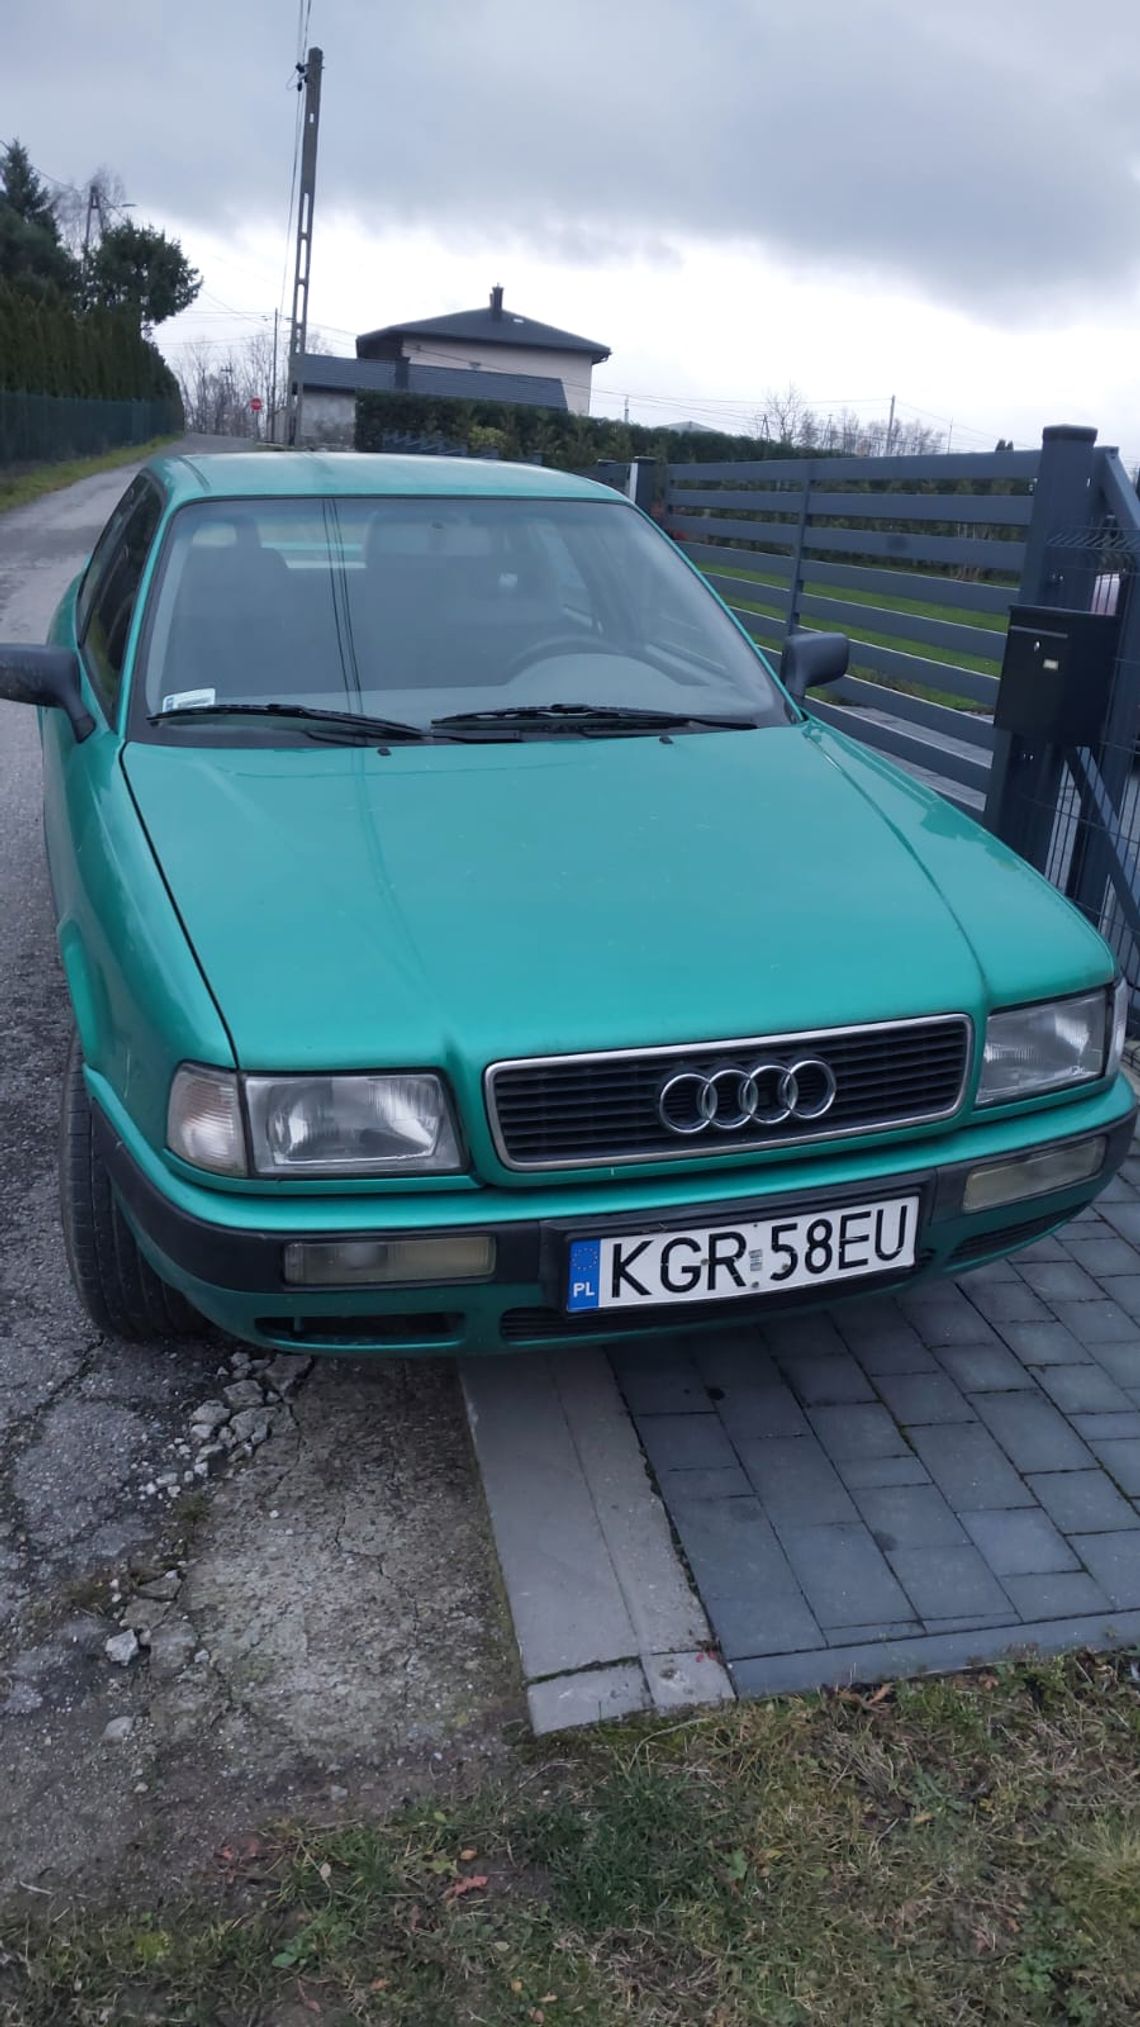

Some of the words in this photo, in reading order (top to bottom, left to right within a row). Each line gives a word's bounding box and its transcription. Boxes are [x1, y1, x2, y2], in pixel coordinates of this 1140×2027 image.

[611, 1231, 747, 1298] KGR
[770, 1205, 907, 1281] 58EU
[573, 1282, 595, 1297] PL
